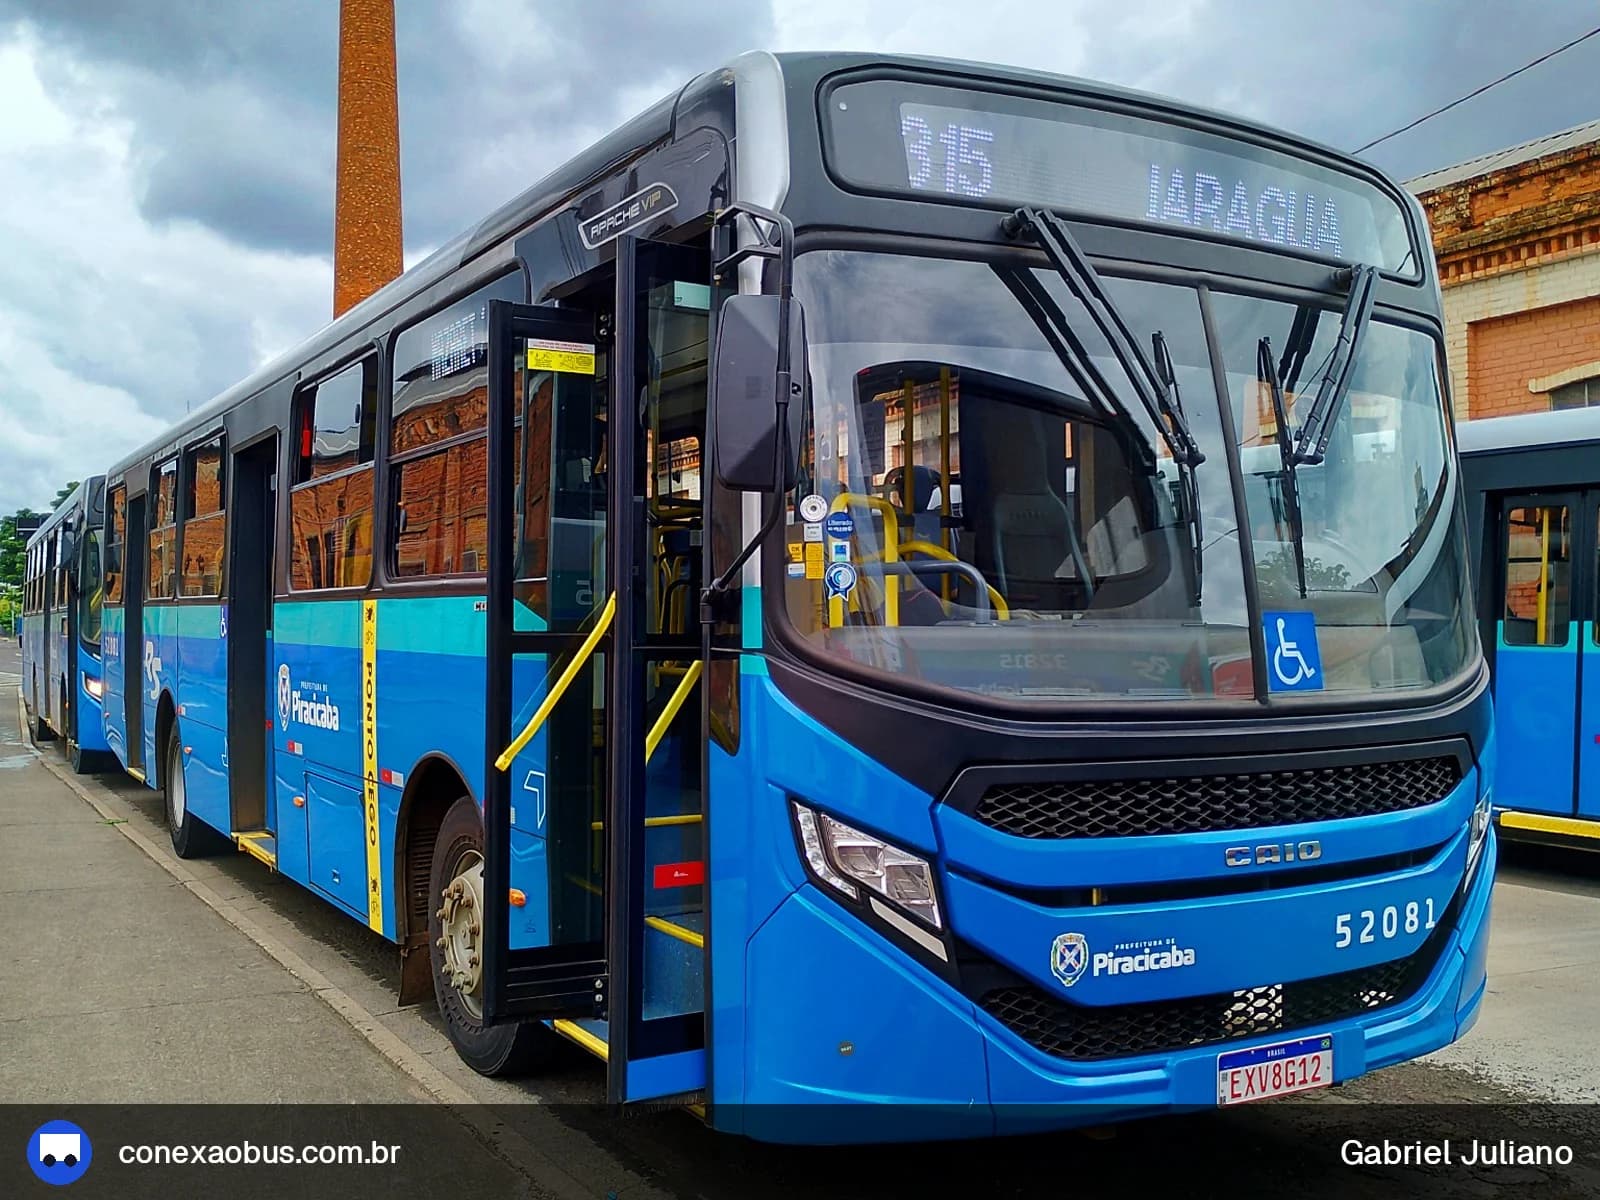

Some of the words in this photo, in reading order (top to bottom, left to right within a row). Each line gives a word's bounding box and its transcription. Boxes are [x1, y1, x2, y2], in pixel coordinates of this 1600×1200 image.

[901, 115, 994, 198] 315
[590, 201, 640, 240] APACHE
[641, 190, 661, 211] VIP
[291, 690, 340, 731] Piracicaba
[365, 661, 374, 761] PONTO
[367, 770, 376, 847] CEGO
[1225, 840, 1323, 867] CAIO
[1114, 939, 1163, 951] PREFEITURA
[1165, 937, 1176, 946] DE
[1335, 897, 1436, 949] 52081
[1093, 944, 1196, 977] Piracicaba
[1267, 1047, 1287, 1058] BRASIL
[1230, 1055, 1322, 1100] EXV8G12
